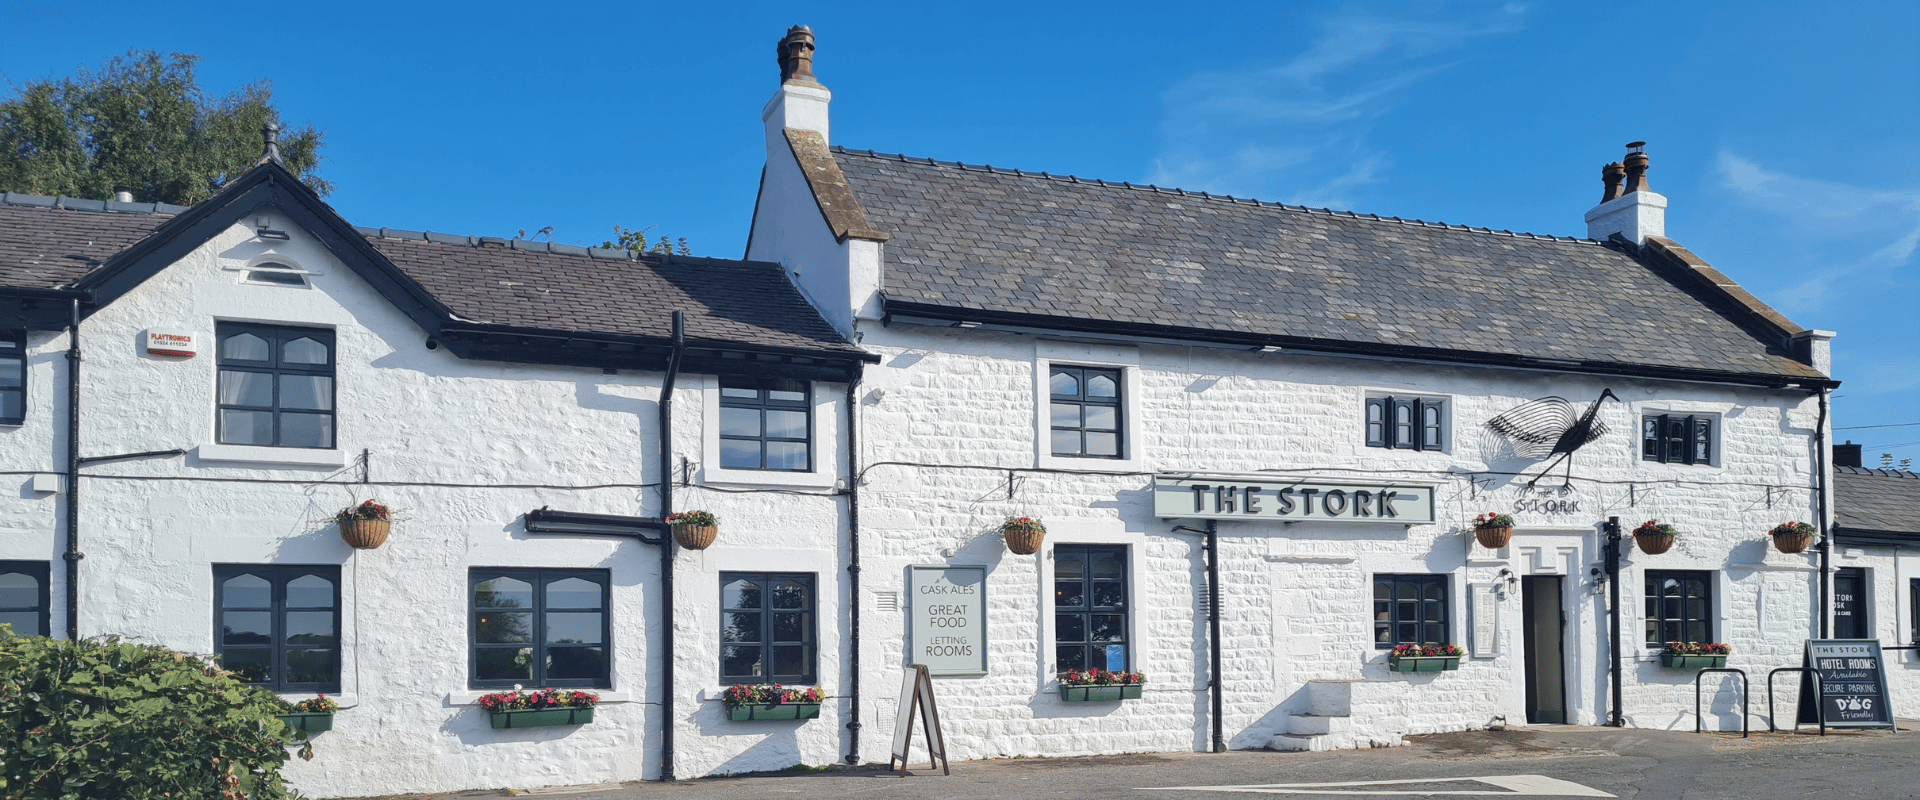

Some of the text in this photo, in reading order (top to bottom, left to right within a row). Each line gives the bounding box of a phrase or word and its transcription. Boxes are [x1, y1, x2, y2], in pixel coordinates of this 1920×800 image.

[151, 333, 191, 342] PLAYTRONICS
[1191, 485, 1399, 518] THE STORK
[1519, 499, 1582, 513] STORK
[920, 585, 975, 595] CASK ALES
[928, 604, 968, 616] GREAT
[930, 617, 967, 628] FOOD
[930, 636, 967, 645] LETTING
[926, 645, 972, 656] ROOMS
[1820, 658, 1876, 670] HOTEL ROOMS
[1829, 670, 1868, 680] Available
[1823, 684, 1877, 693] SECURE PARKING
[1840, 710, 1874, 720] Friendly
